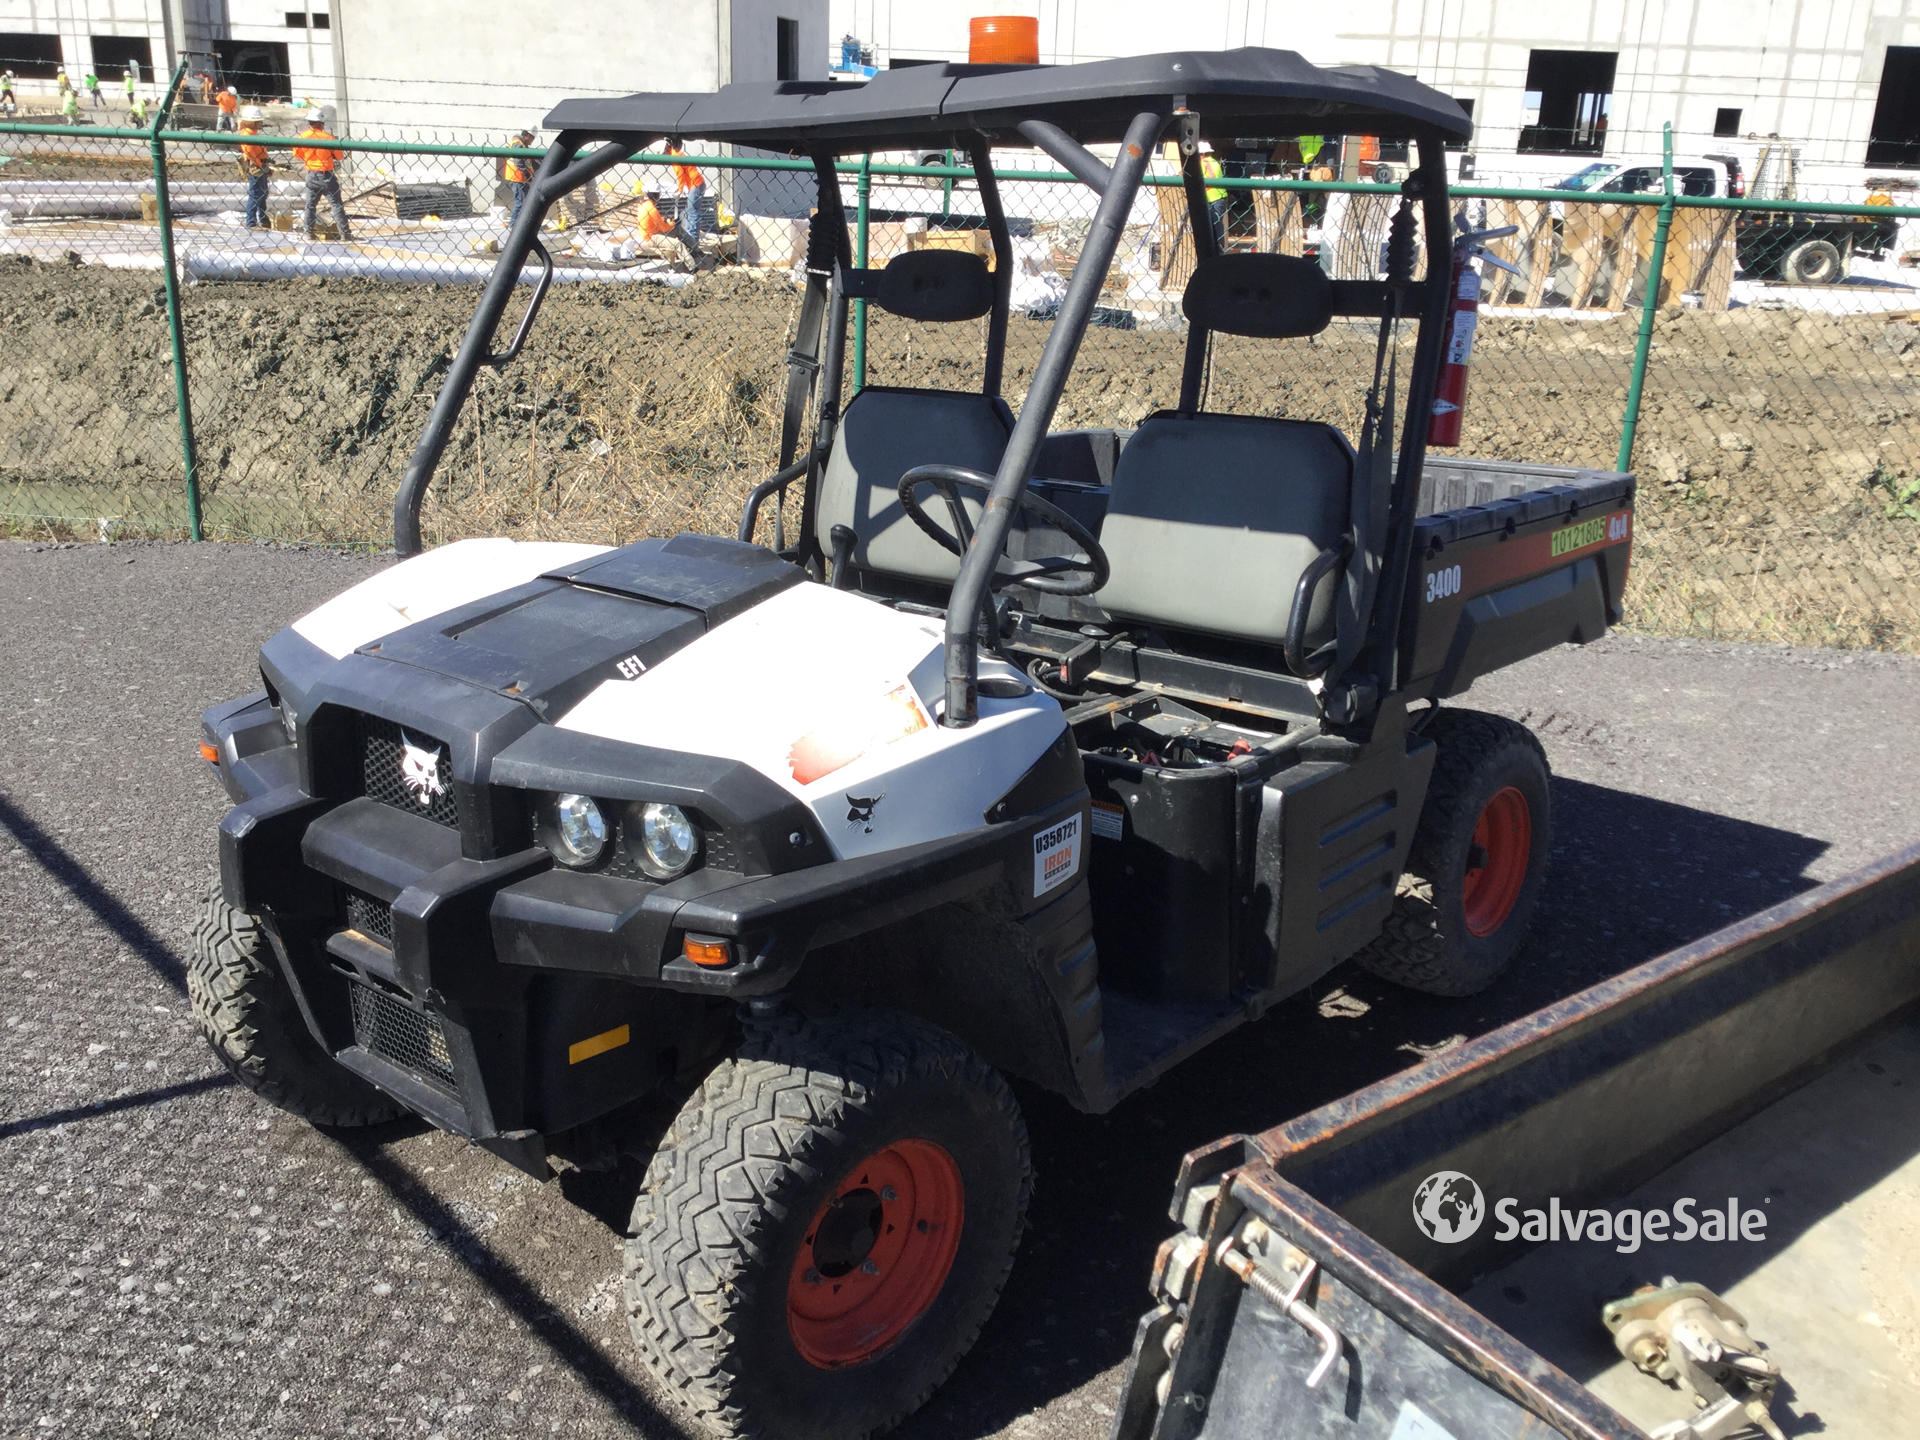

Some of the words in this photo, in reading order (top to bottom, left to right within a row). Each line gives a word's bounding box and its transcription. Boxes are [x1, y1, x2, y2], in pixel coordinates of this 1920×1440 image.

[1608, 513, 1629, 541] 4x4
[1426, 564, 1461, 603] 3400
[616, 654, 647, 679] EFI
[1035, 819, 1077, 854] U358721
[1044, 846, 1073, 872] IRON
